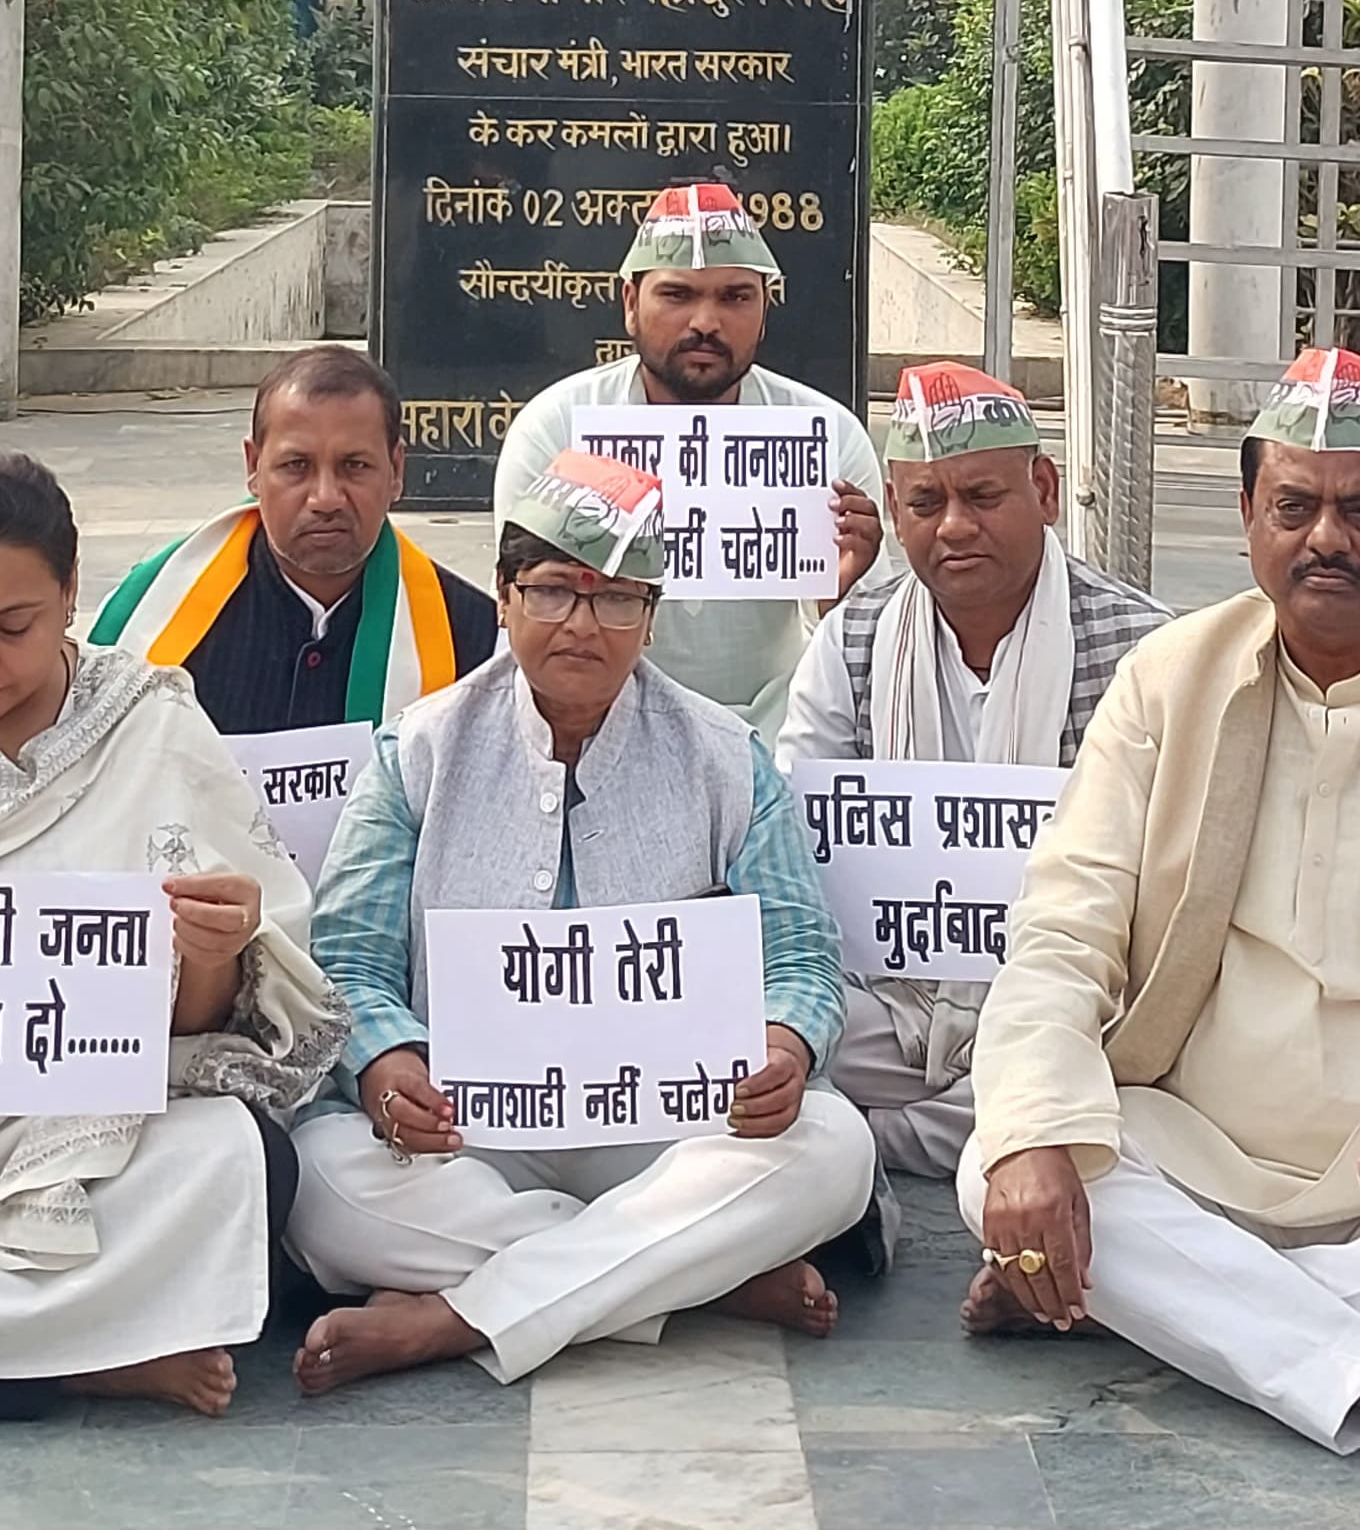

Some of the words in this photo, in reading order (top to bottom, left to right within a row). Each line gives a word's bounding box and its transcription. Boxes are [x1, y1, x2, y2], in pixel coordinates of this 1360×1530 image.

[457, 38, 553, 81] संचार
[620, 48, 688, 81] भारत
[693, 51, 795, 84] सरकार
[468, 110, 500, 149] के
[506, 119, 558, 151] कर
[560, 111, 650, 152] कमलों
[654, 122, 717, 158] द्वारा
[423, 176, 513, 226] दिनांक
[522, 189, 564, 228] 02
[678, 415, 710, 487] की
[723, 416, 829, 488] तानाशाही
[262, 758, 350, 805] सरकार
[804, 774, 913, 864] पुलिस
[934, 795, 1057, 850] प्रशास
[38, 908, 151, 967] जनता
[872, 880, 1009, 971] मुर्दाबाद
[500, 921, 594, 1006] योगी
[615, 916, 683, 1003] तेरी
[583, 1065, 641, 1128] नहीं
